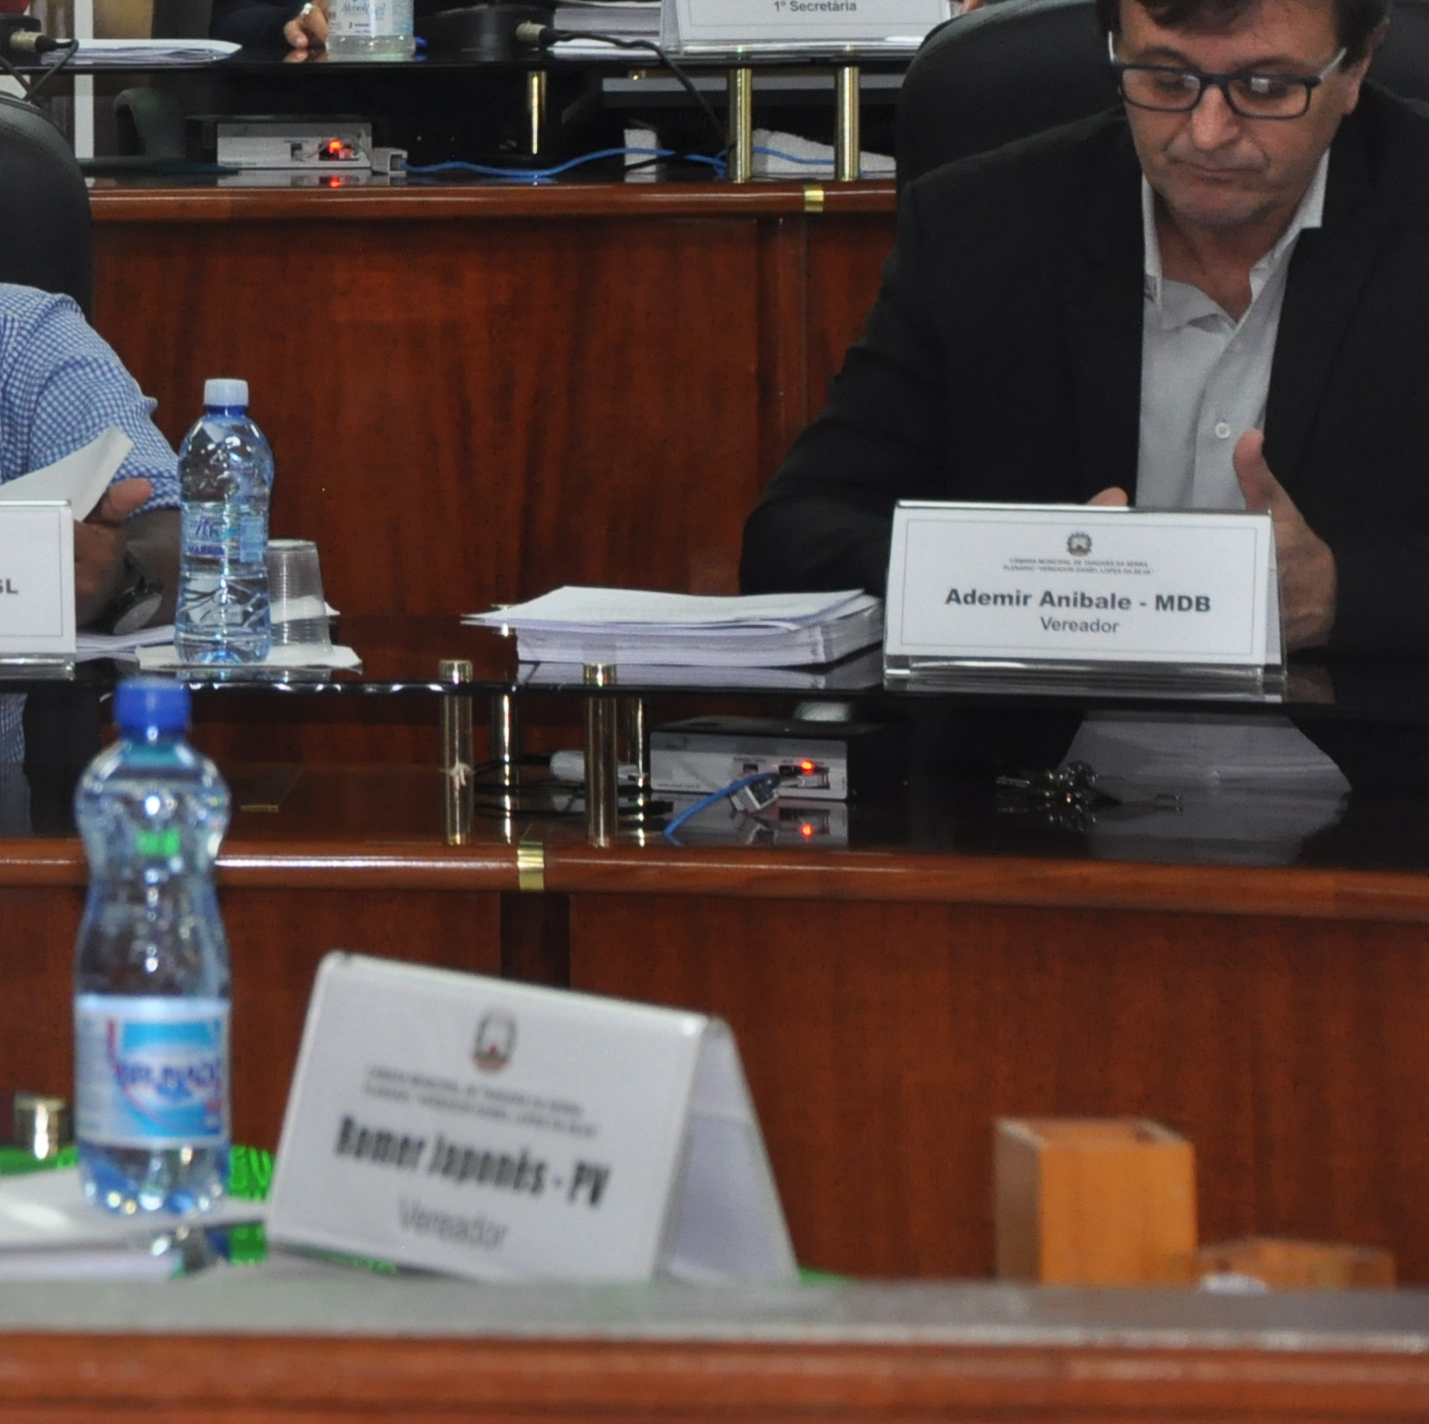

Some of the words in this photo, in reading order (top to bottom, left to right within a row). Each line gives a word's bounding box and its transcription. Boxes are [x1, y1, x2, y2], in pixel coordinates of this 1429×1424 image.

[790, 0, 857, 12] Secretária
[944, 588, 1032, 608] Ademir
[1039, 590, 1132, 610] Anibale
[1154, 594, 1212, 612] MDB
[1040, 616, 1121, 634] Vereador
